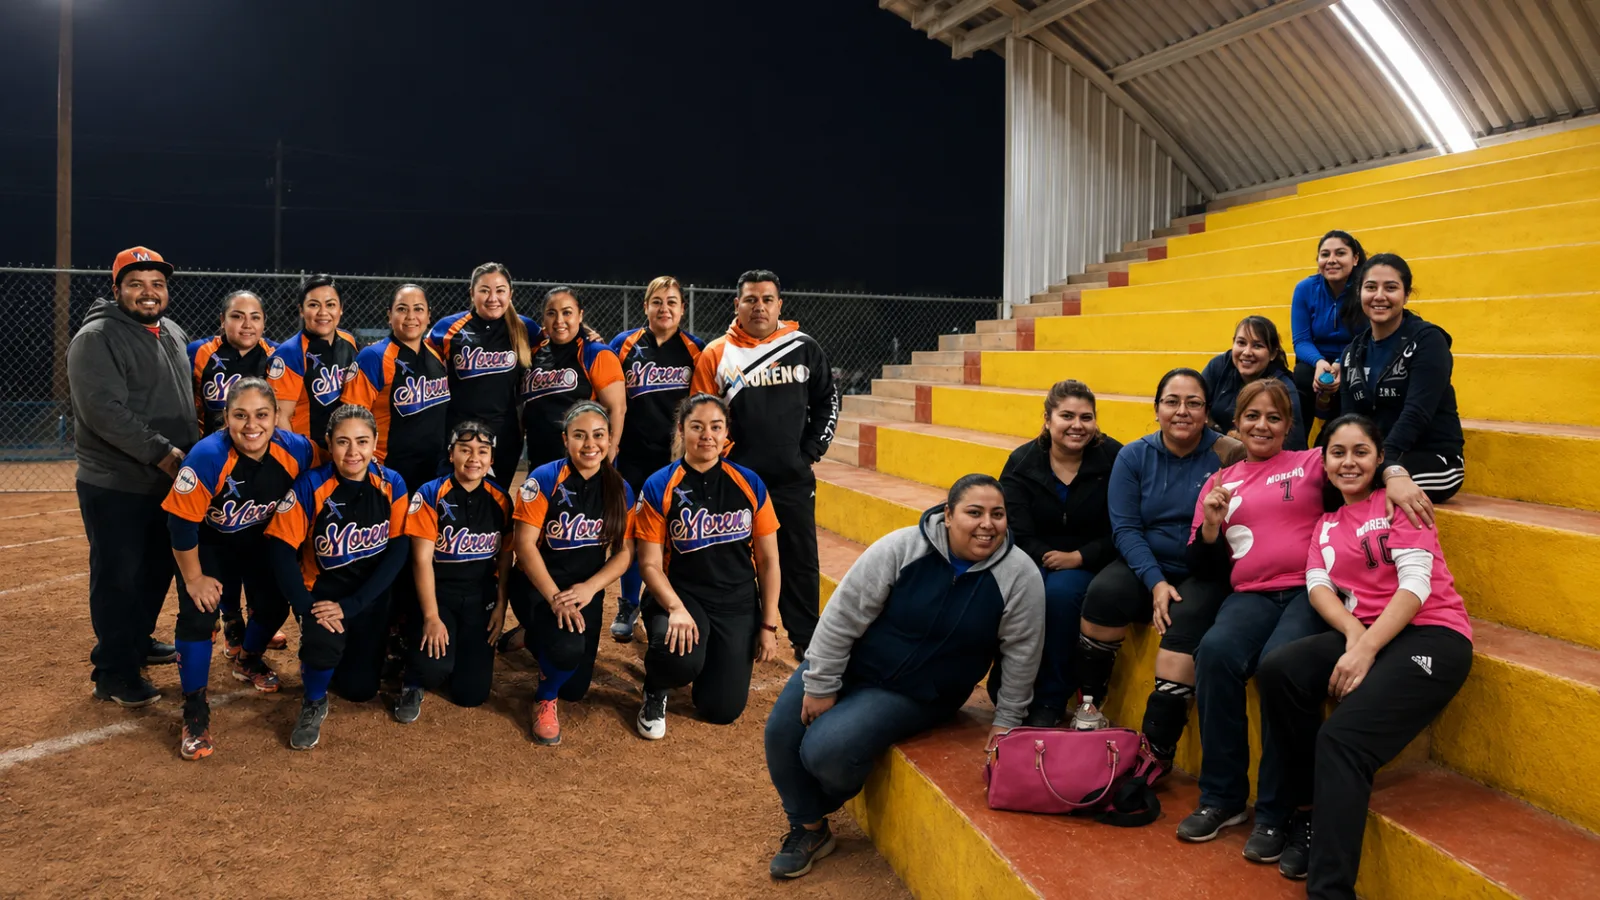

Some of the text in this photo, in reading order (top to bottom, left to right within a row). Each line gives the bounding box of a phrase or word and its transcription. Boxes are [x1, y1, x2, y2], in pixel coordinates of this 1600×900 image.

[393, 375, 450, 404] Moren
[625, 361, 692, 389] Moreno
[206, 499, 277, 528] More
[546, 511, 604, 541] More
[669, 507, 752, 540] Moreno
[1356, 517, 1391, 538] MOREN
[315, 519, 391, 557] Moren
